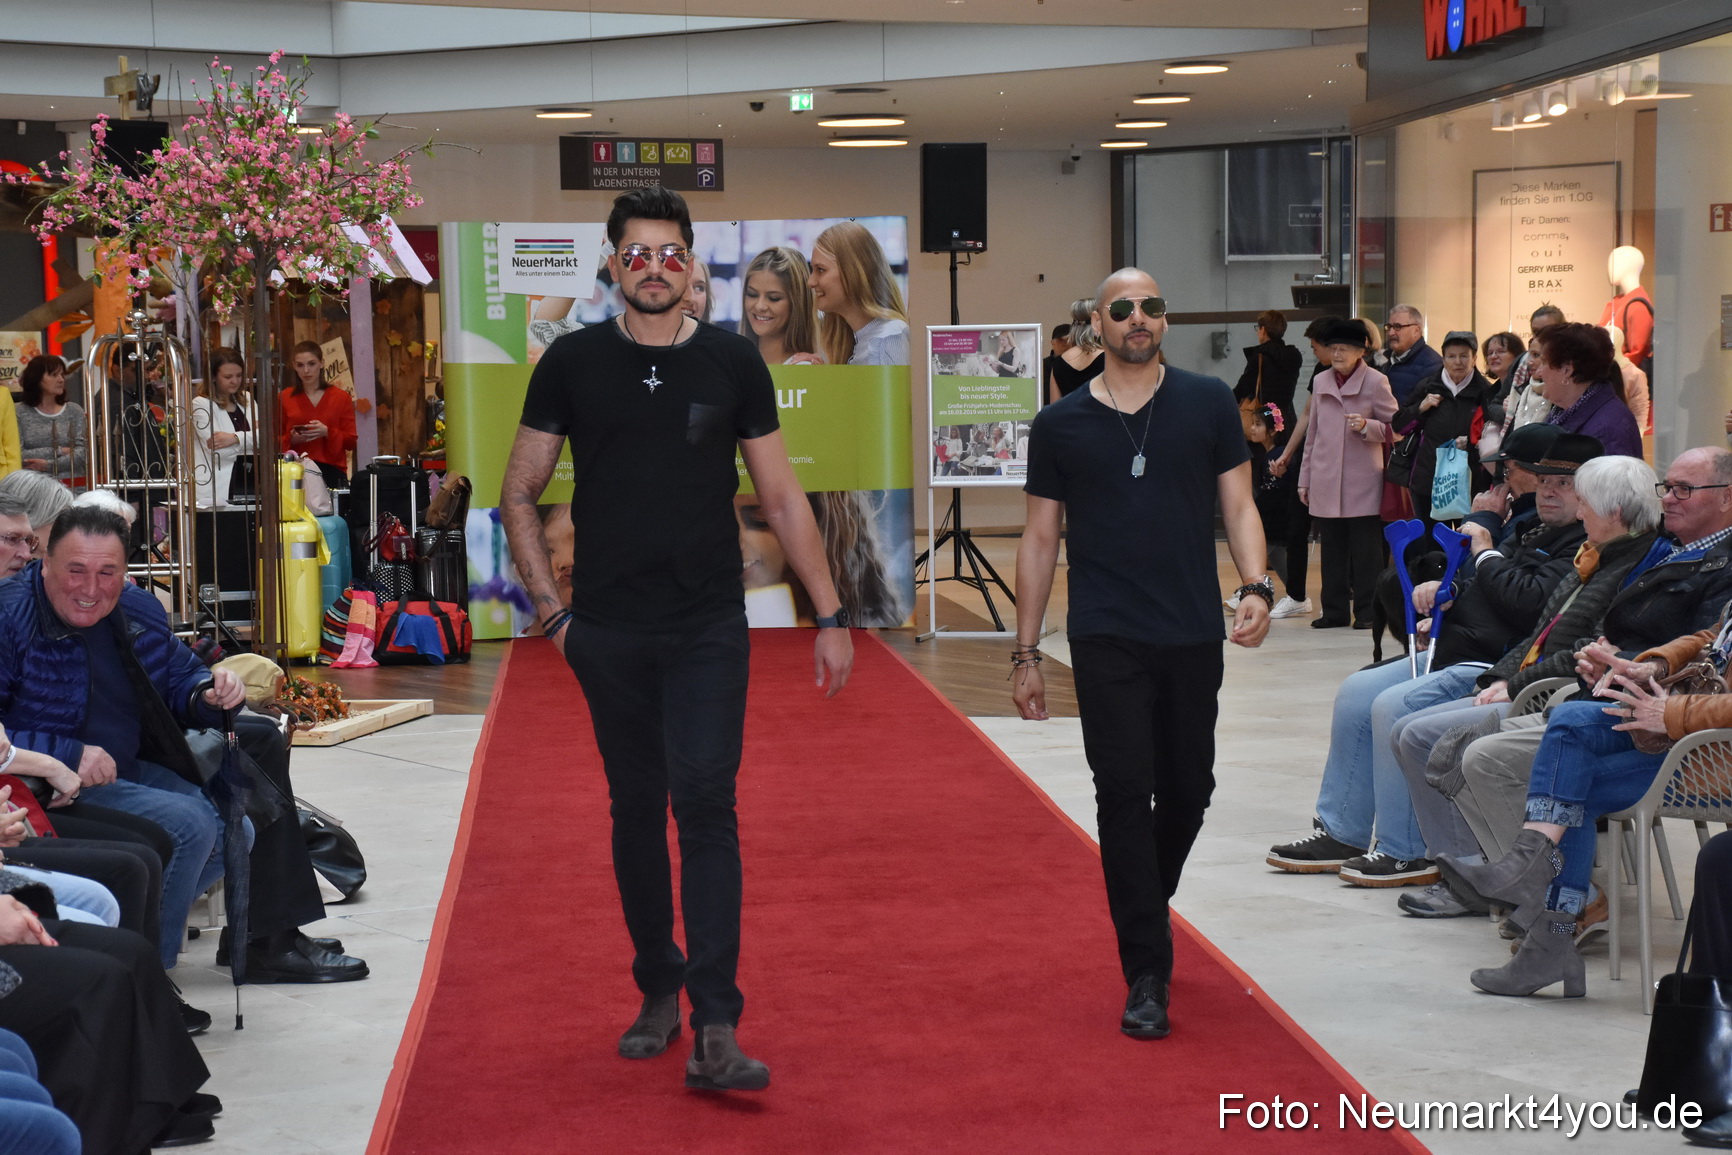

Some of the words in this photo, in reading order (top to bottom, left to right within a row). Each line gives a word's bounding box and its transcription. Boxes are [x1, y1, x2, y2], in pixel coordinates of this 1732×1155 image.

[593, 167, 601, 176] IN
[603, 167, 619, 176] DER
[621, 167, 661, 177] UNTEREN
[593, 178, 661, 188] LADENSTRASSE
[702, 174, 711, 185] P
[1511, 183, 1541, 193] Diese
[1543, 181, 1581, 191] Marken
[1500, 195, 1531, 206] finden
[1534, 194, 1550, 205] Sie
[1553, 193, 1566, 203] im
[1569, 191, 1594, 203] 1.OG
[1521, 216, 1535, 225] Für
[1538, 215, 1571, 225] Damen:
[1523, 232, 1569, 242] comma,
[512, 257, 579, 268] NeuerMarkt
[1517, 265, 1545, 274] GERRY
[1545, 264, 1574, 273] WEBER
[1528, 279, 1563, 289] BRAX
[971, 384, 1011, 393] Lieblingsteil
[777, 388, 808, 409] ur
[990, 392, 1009, 400] Style.
[787, 454, 816, 465] nomie,
